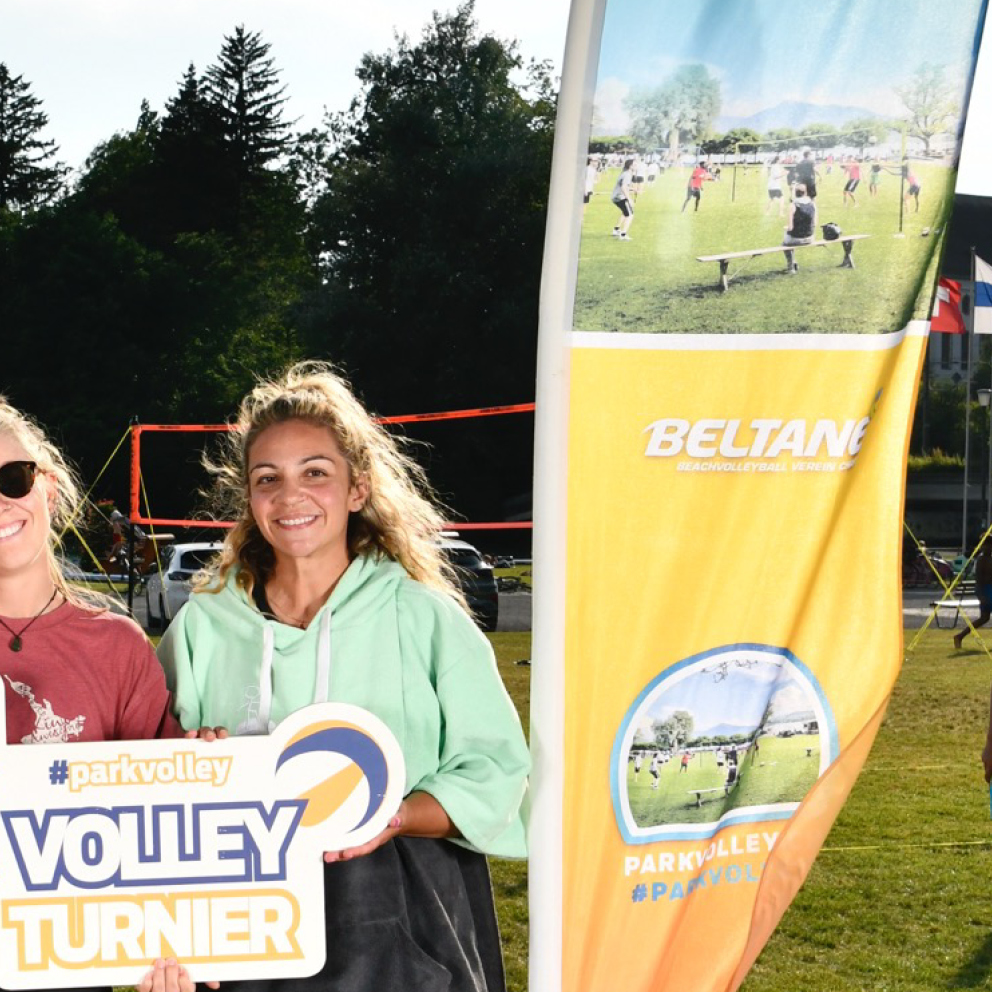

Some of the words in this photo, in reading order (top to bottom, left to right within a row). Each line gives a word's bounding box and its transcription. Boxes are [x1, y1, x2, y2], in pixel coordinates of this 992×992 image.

[642, 417, 870, 457] BELTANE
[676, 461, 787, 472] BEACHVOLLEYBALL
[791, 461, 836, 472] VEREIN
[49, 751, 233, 792] #parkvolley
[0, 799, 309, 891] VOLLEY
[1, 888, 305, 971] TURNIER
